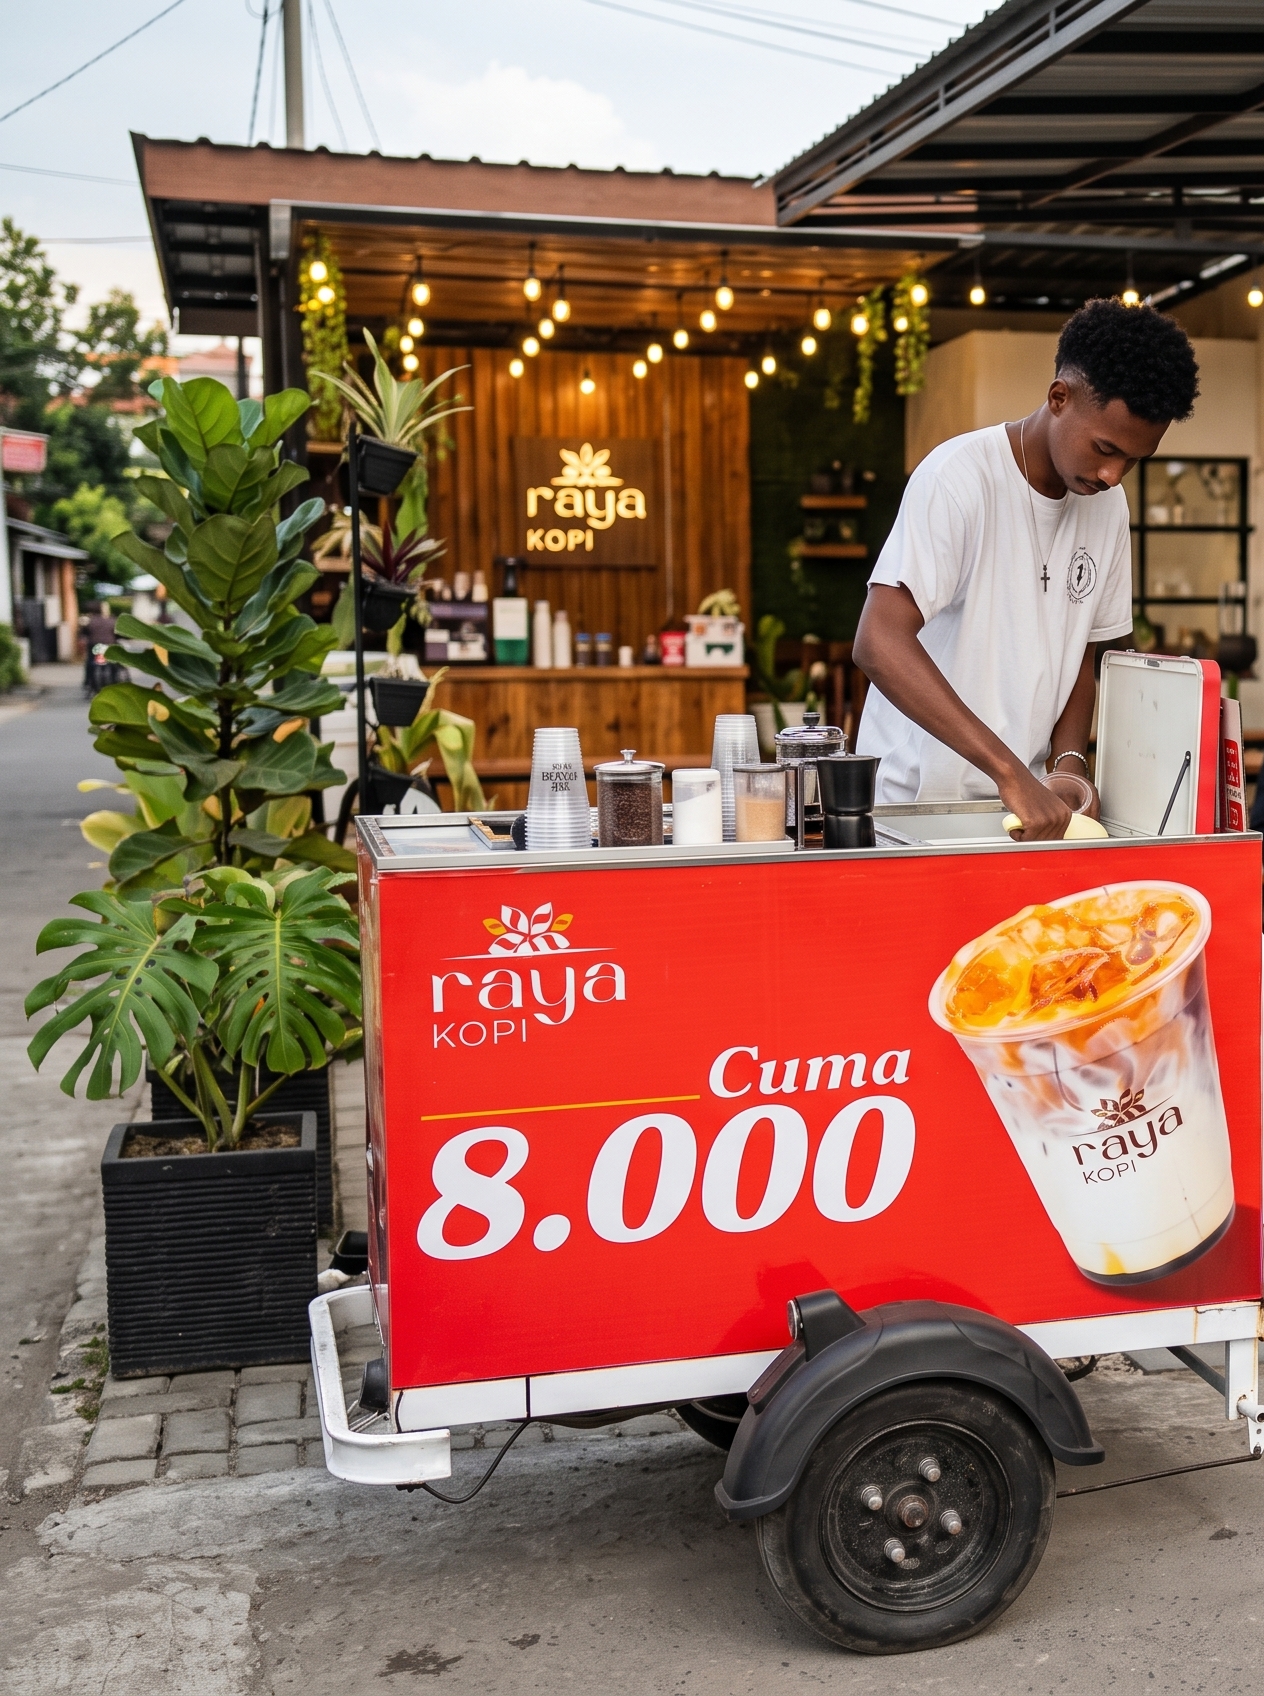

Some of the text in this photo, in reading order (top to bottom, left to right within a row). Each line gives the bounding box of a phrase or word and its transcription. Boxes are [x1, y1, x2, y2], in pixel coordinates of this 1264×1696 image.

[526, 486, 647, 530] raya
[526, 528, 594, 552] KOPI
[431, 962, 627, 1026] raya
[432, 1018, 527, 1049] KOPI
[708, 1045, 911, 1099] Cuma
[1072, 1106, 1183, 1166] raya
[416, 1095, 917, 1261] 8.000
[1082, 1159, 1137, 1185] KOPI
